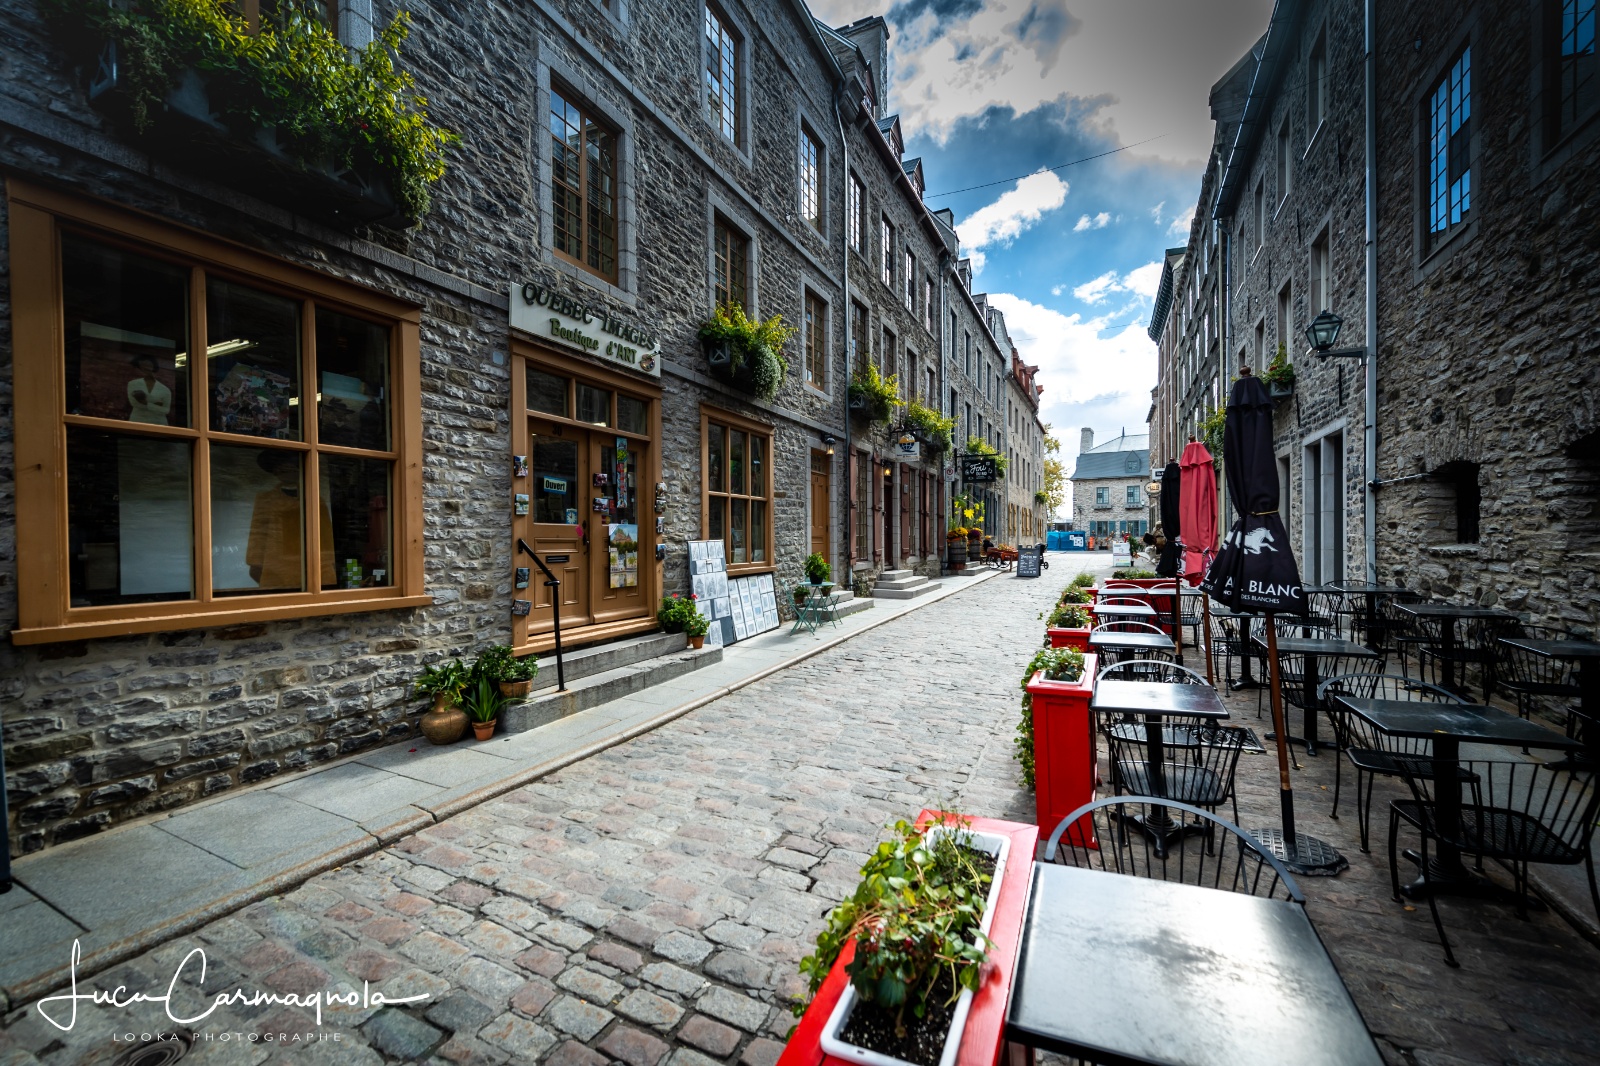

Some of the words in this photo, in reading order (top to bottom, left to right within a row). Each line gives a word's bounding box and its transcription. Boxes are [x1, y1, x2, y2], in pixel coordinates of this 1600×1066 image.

[550, 318, 600, 351] Boutique
[606, 341, 638, 364] d'ART
[601, 313, 656, 351] IMAGES
[545, 480, 566, 491] Ouvert
[1248, 580, 1301, 599] BLANC
[1251, 595, 1280, 604] BLANCHES
